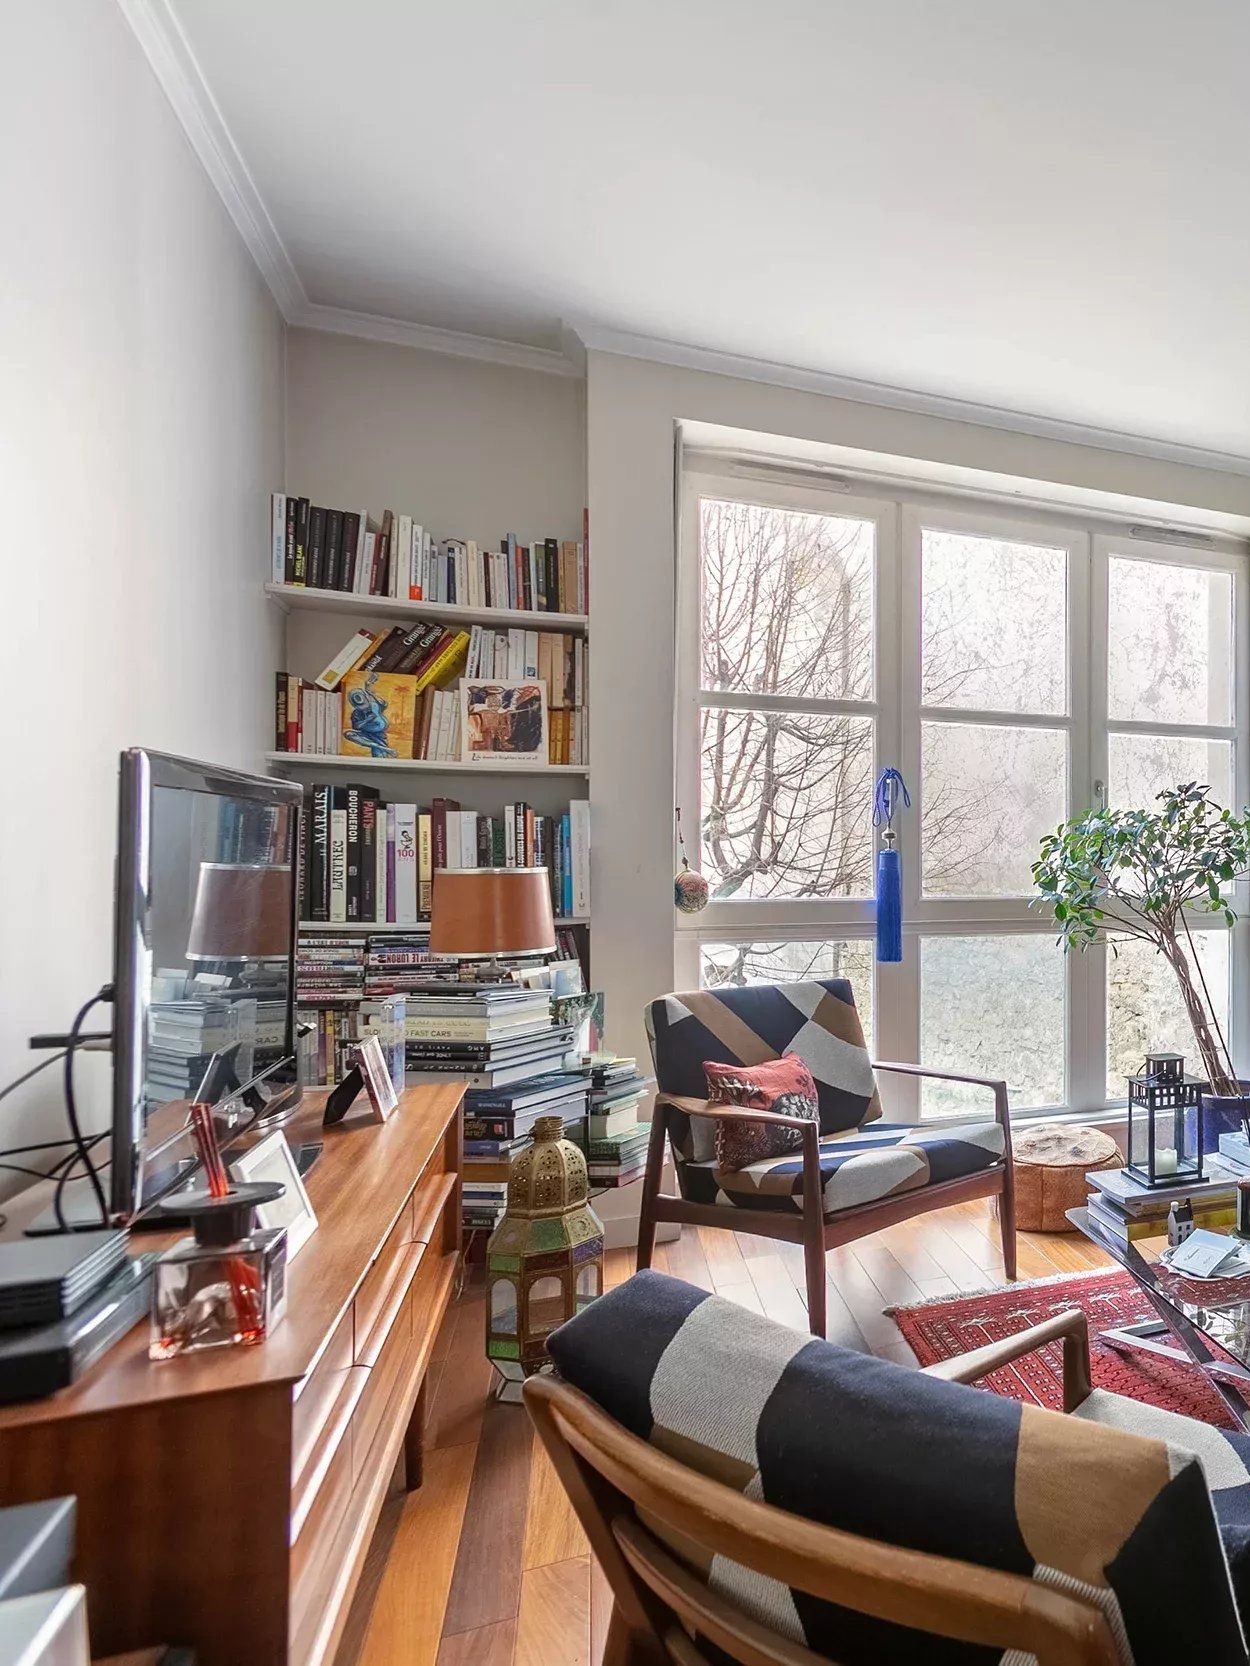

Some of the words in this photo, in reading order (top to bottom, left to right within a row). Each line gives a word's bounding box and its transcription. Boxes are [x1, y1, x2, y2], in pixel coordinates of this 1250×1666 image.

[314, 791, 328, 844] MARAIS
[348, 790, 358, 843] BOUCHERON
[332, 840, 343, 891] LAUTREC
[396, 849, 415, 858] 100
[386, 953, 409, 963] LURON
[412, 954, 420, 962] LE
